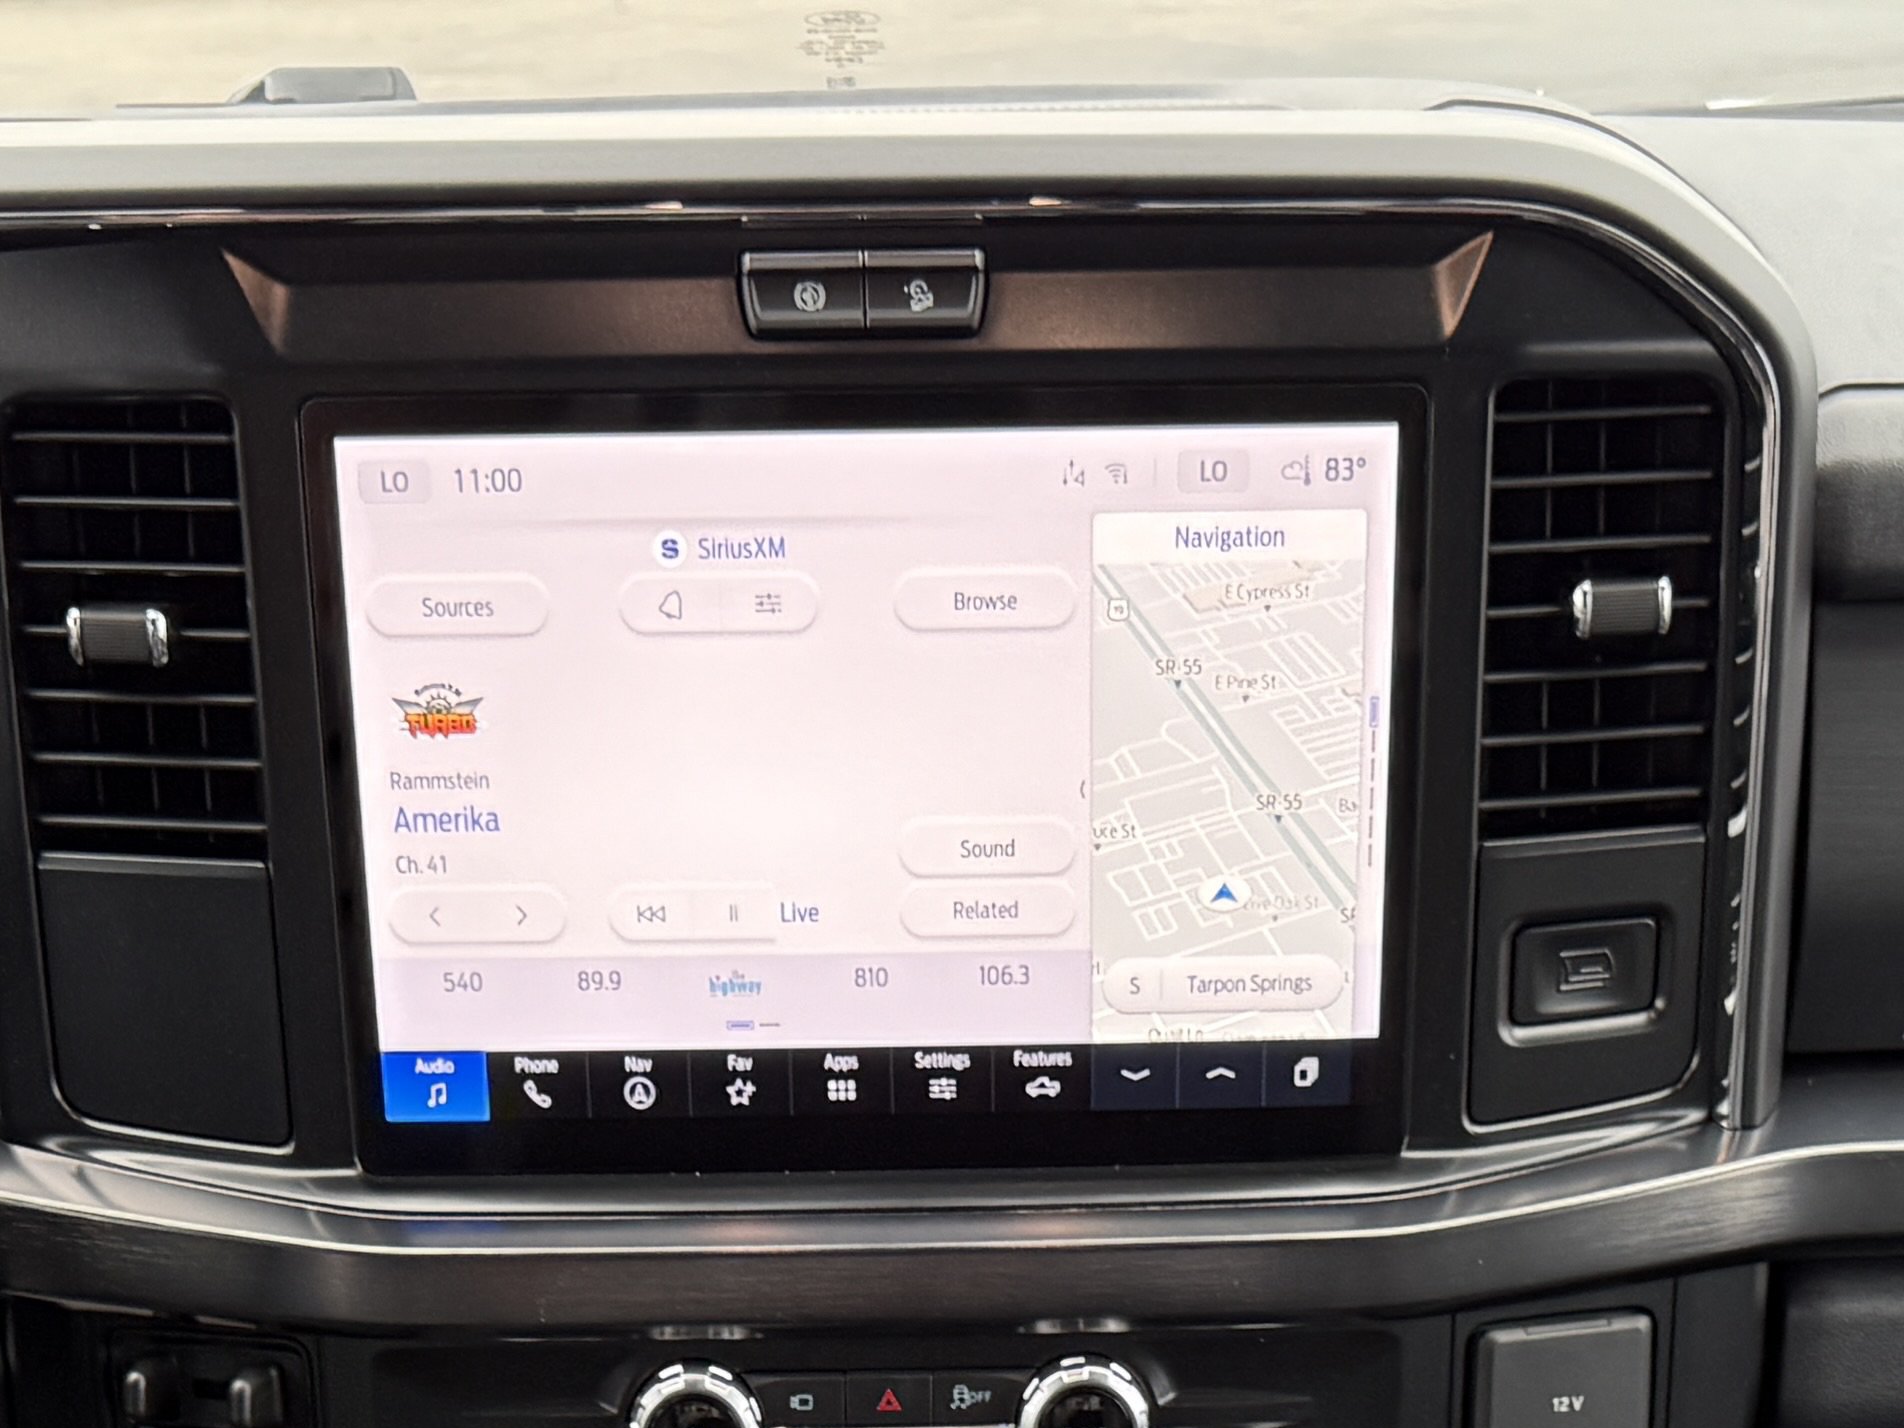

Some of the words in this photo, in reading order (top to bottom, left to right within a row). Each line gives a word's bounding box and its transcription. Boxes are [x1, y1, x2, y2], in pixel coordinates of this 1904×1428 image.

[1199, 460, 1228, 484] LO
[1324, 456, 1367, 482] 83°
[380, 471, 410, 494] LO
[454, 468, 523, 494] 11:00
[698, 537, 787, 560] SiriusXM
[1174, 526, 1286, 552] Navigation
[954, 592, 1018, 613] Browse
[1237, 584, 1291, 601] Cypress
[421, 598, 494, 619] Sources
[390, 771, 490, 791] Rammstein
[394, 806, 501, 833] Amerika
[959, 839, 1016, 859] Sound
[395, 855, 424, 874] Ch.
[427, 855, 447, 874] 41
[780, 901, 820, 923] Live
[953, 900, 1019, 920] Related
[442, 971, 483, 992] 540
[577, 970, 622, 991] 89.9
[854, 966, 889, 987] 810
[979, 965, 1030, 985] 106.3
[1187, 975, 1246, 996] Tarpon
[1250, 974, 1313, 995] Springs
[1129, 977, 1141, 995] S
[414, 1058, 455, 1075] Audio
[514, 1056, 559, 1075] Phone
[624, 1056, 653, 1073] Nav
[727, 1055, 753, 1072] Fav
[824, 1053, 859, 1072] Apps
[914, 1051, 971, 1071] Settings
[1013, 1050, 1073, 1068] Features
[969, 1390, 991, 1404] OFF
